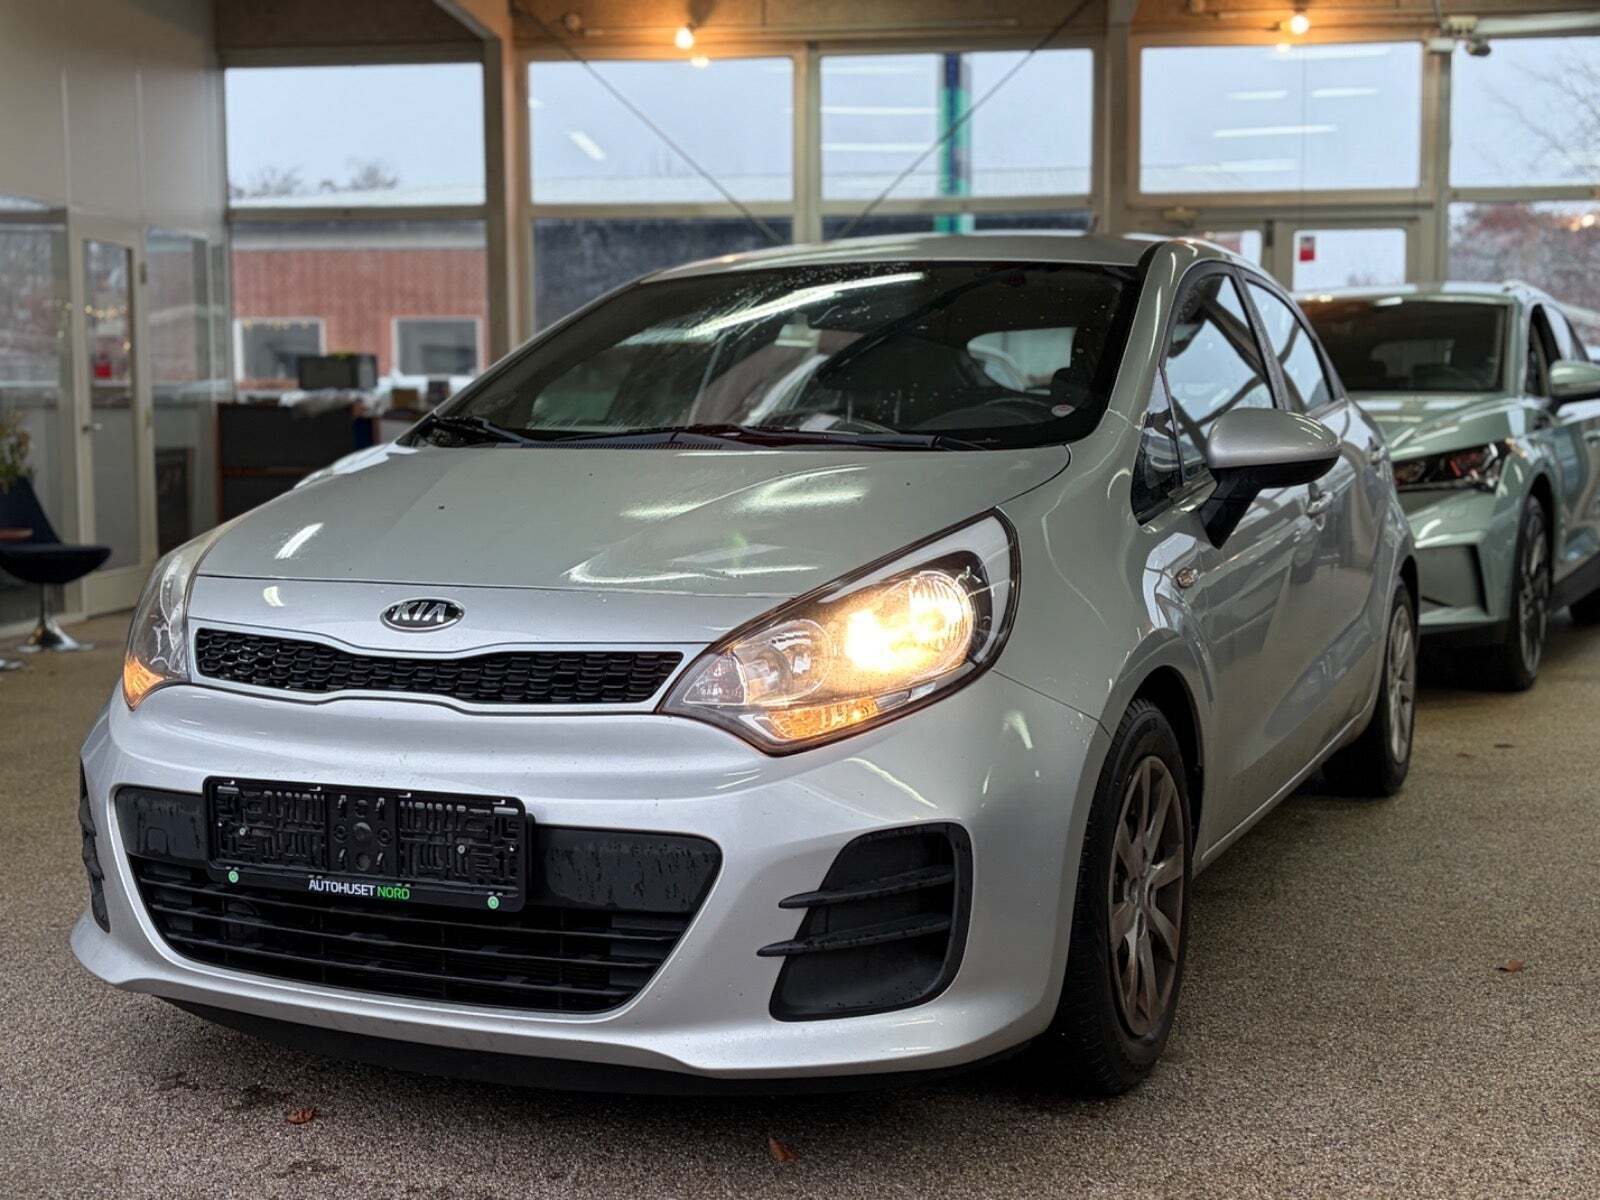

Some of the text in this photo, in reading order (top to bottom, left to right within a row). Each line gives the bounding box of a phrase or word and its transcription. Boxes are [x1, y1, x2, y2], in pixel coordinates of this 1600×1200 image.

[392, 602, 447, 623] KIA
[308, 879, 410, 900] AUTOHUSET NORD
